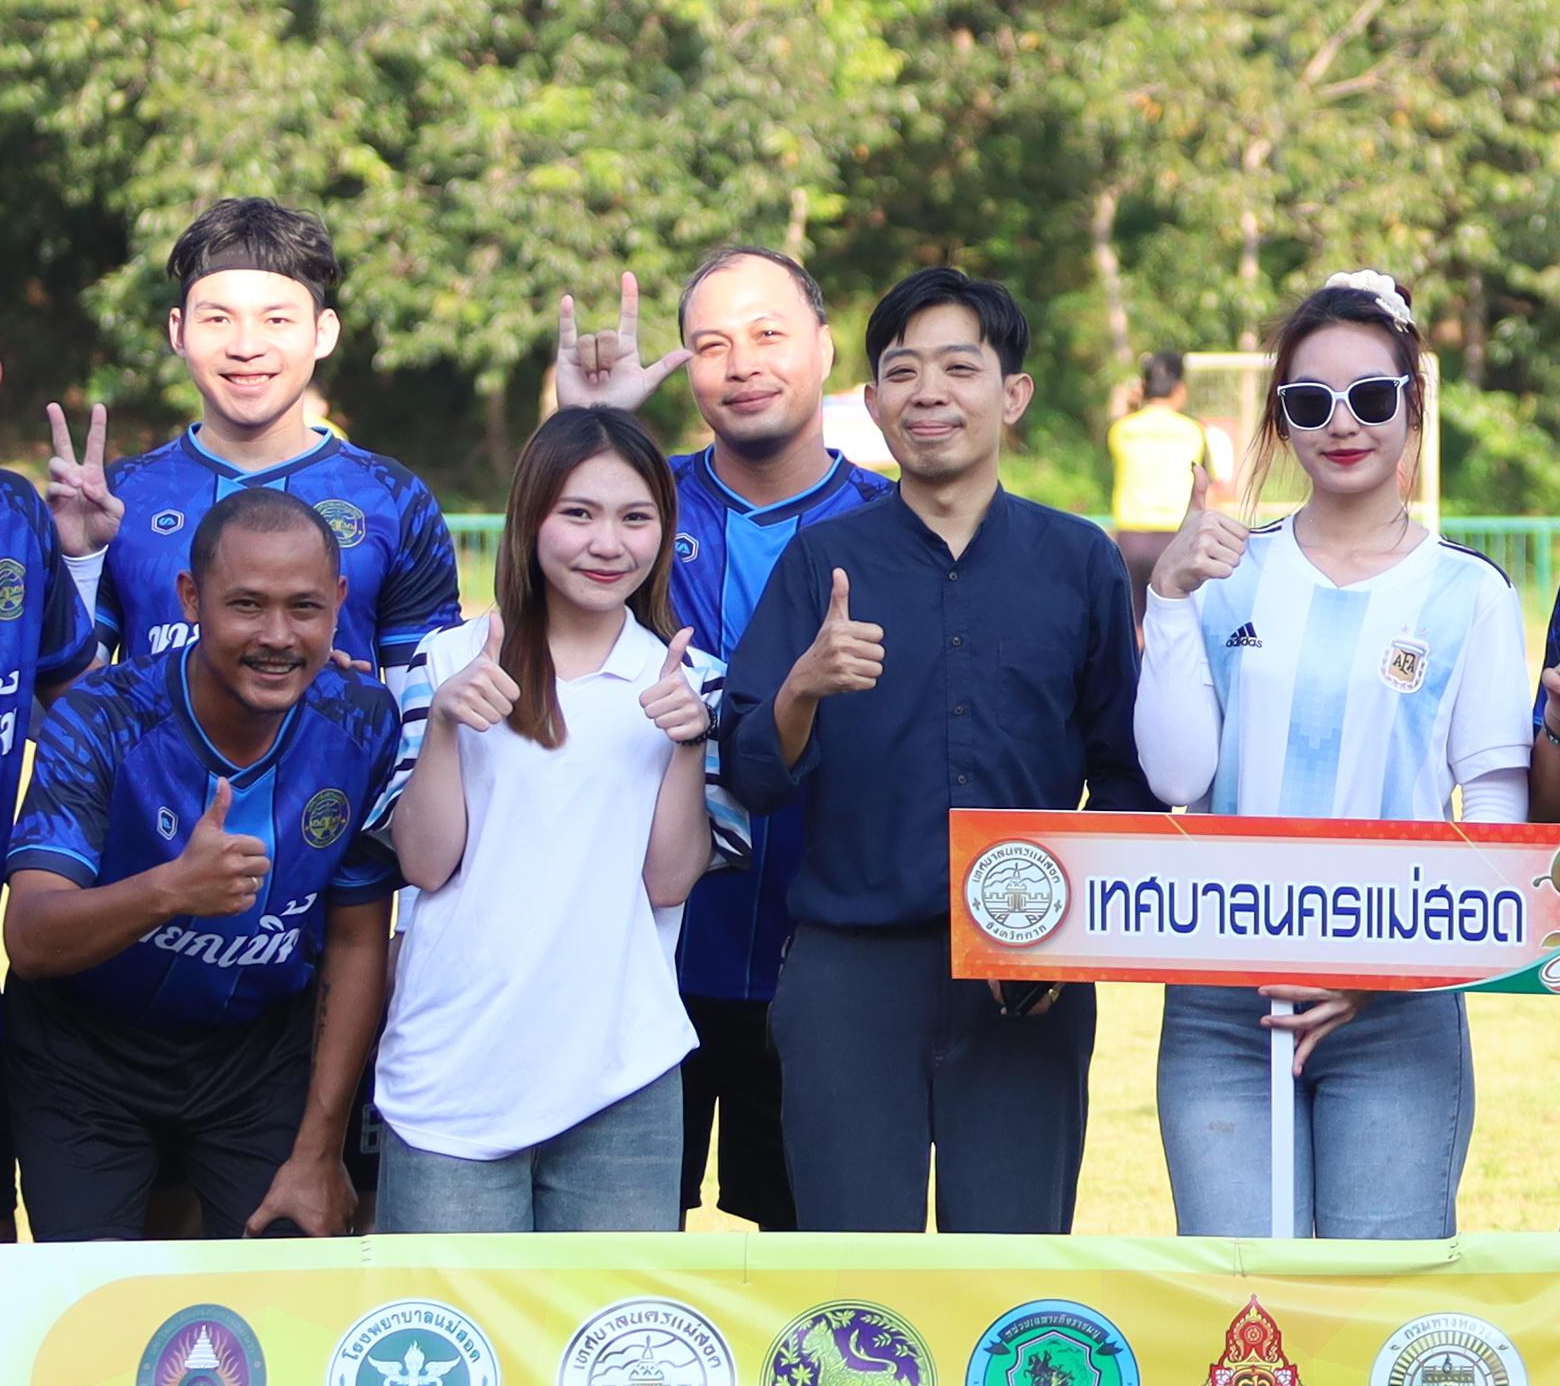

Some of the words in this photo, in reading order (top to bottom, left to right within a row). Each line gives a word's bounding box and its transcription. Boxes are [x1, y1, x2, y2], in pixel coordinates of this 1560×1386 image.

[1225, 635, 1263, 649] adidas
[1087, 865, 1524, 945] เทศบาลนครแม่สอด
[341, 1309, 481, 1364] โรงพยาบาลแม่สอด
